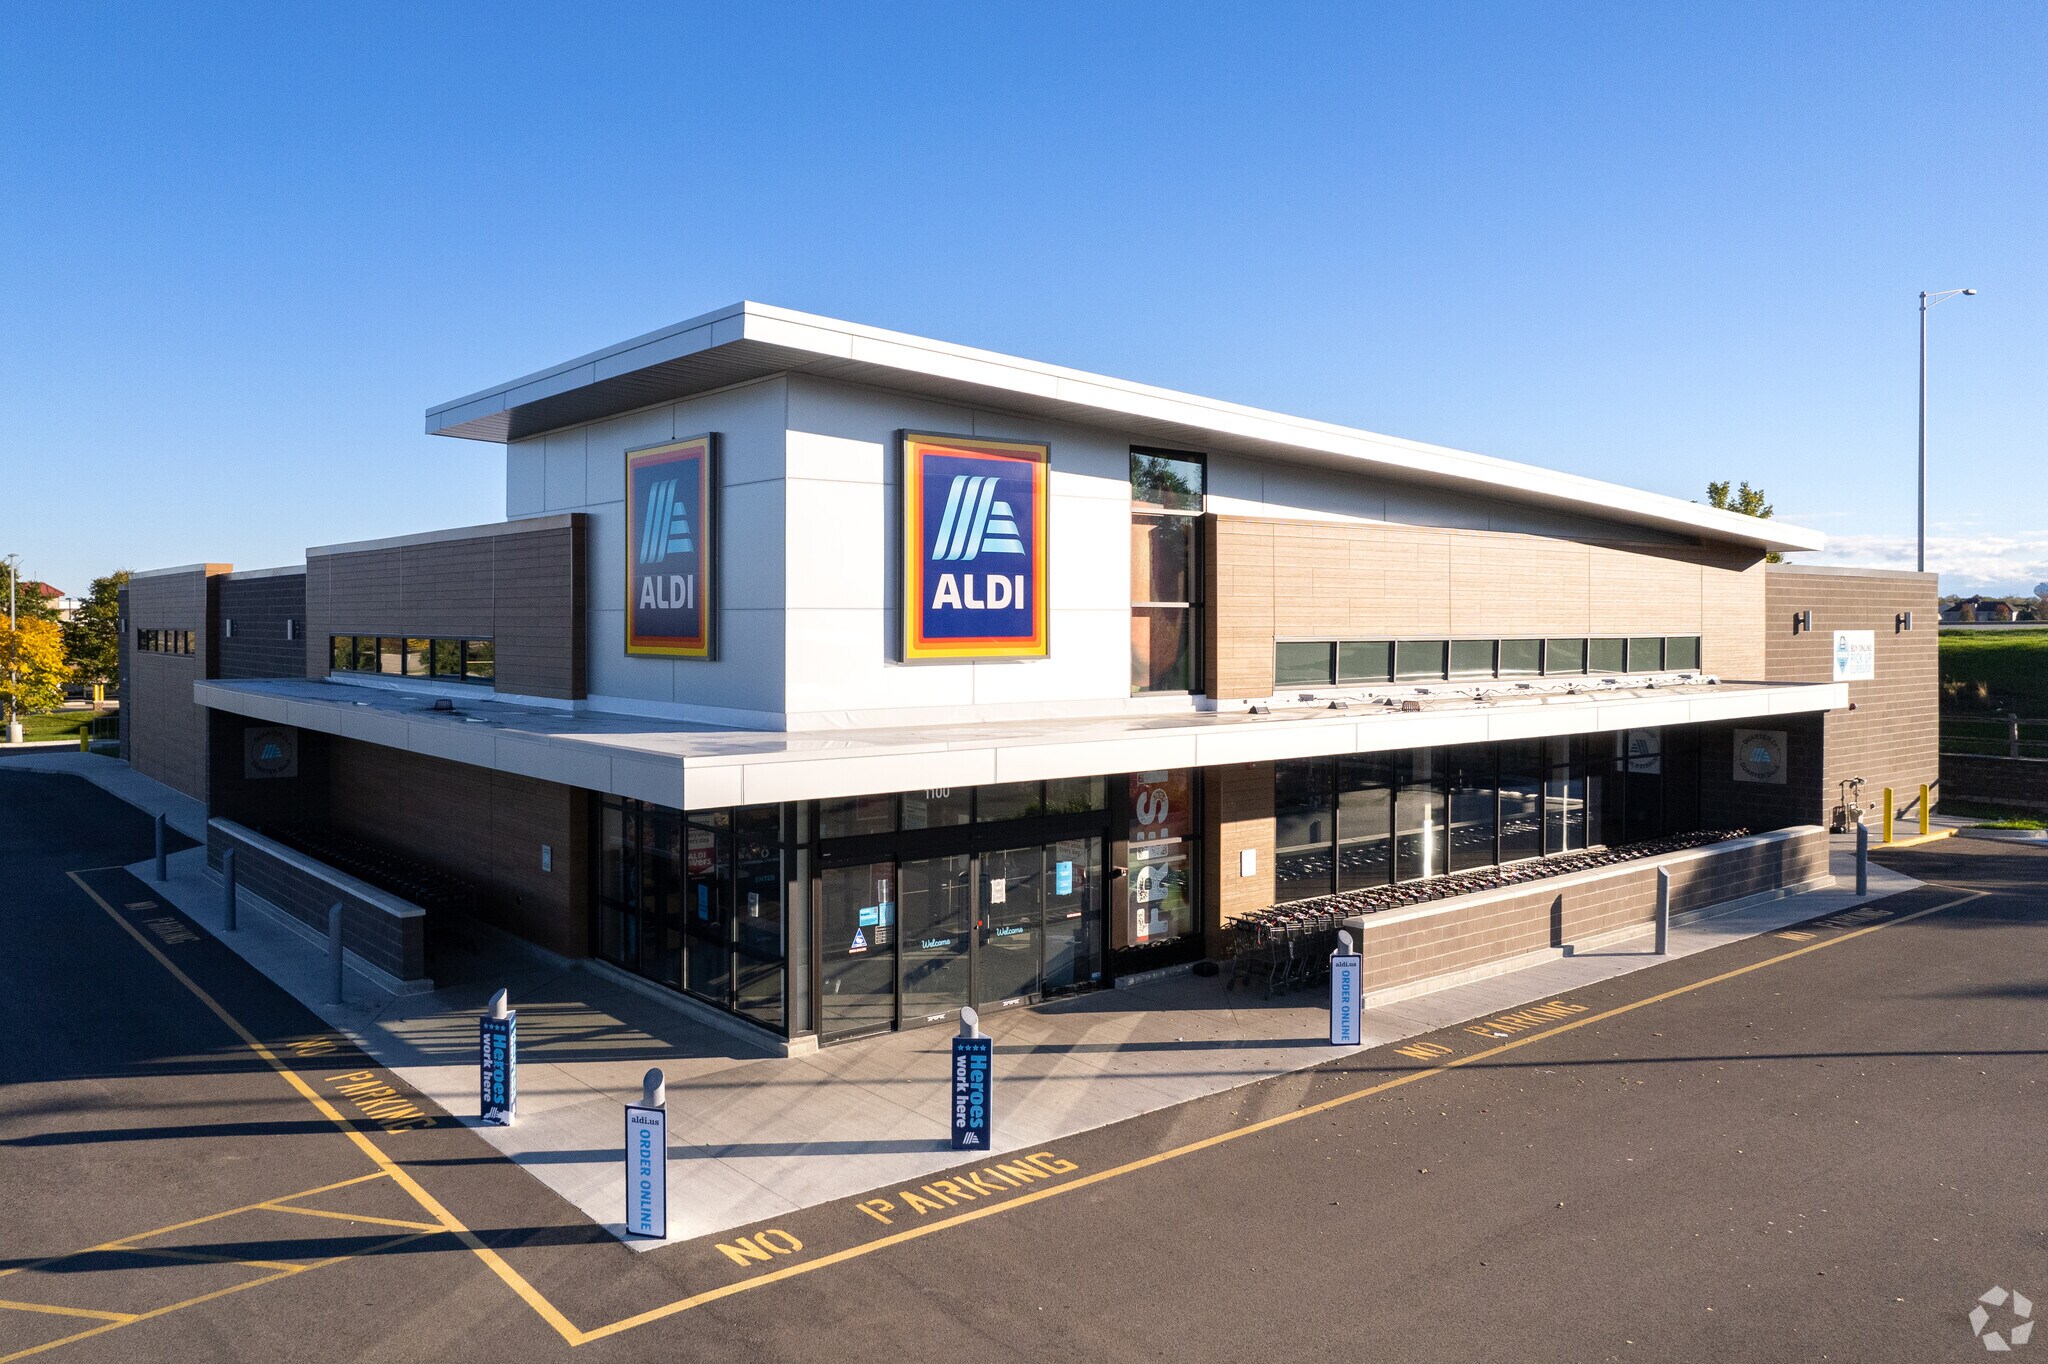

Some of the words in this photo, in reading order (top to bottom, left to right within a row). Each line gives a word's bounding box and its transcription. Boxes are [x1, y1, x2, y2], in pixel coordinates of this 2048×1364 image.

[639, 574, 694, 609] ALDI
[931, 573, 1025, 610] ALDI
[1859, 644, 1872, 652] ONLINE
[926, 787, 950, 799] 1100
[755, 874, 776, 883] ENTER
[921, 938, 951, 949] Welcome
[996, 927, 1024, 937] Welcome
[1341, 970, 1350, 1003] ORDER
[1341, 1005, 1350, 1041] ONLINE
[1393, 1041, 1453, 1061] NO
[1463, 1000, 1590, 1039] PARKING
[483, 1033, 493, 1069] work
[493, 1033, 507, 1105] Heroes
[286, 1036, 339, 1057] NO
[325, 1070, 437, 1135] PARKING
[483, 1070, 493, 1103] here
[957, 1055, 969, 1092] work
[969, 1055, 987, 1128] Heroes
[631, 1115, 660, 1126] aldi.us
[956, 1095, 969, 1128] here
[639, 1128, 651, 1176] ORDER
[640, 1180, 652, 1231] ONLINE
[714, 1228, 806, 1267] NO
[855, 1151, 1080, 1225] PARKING
